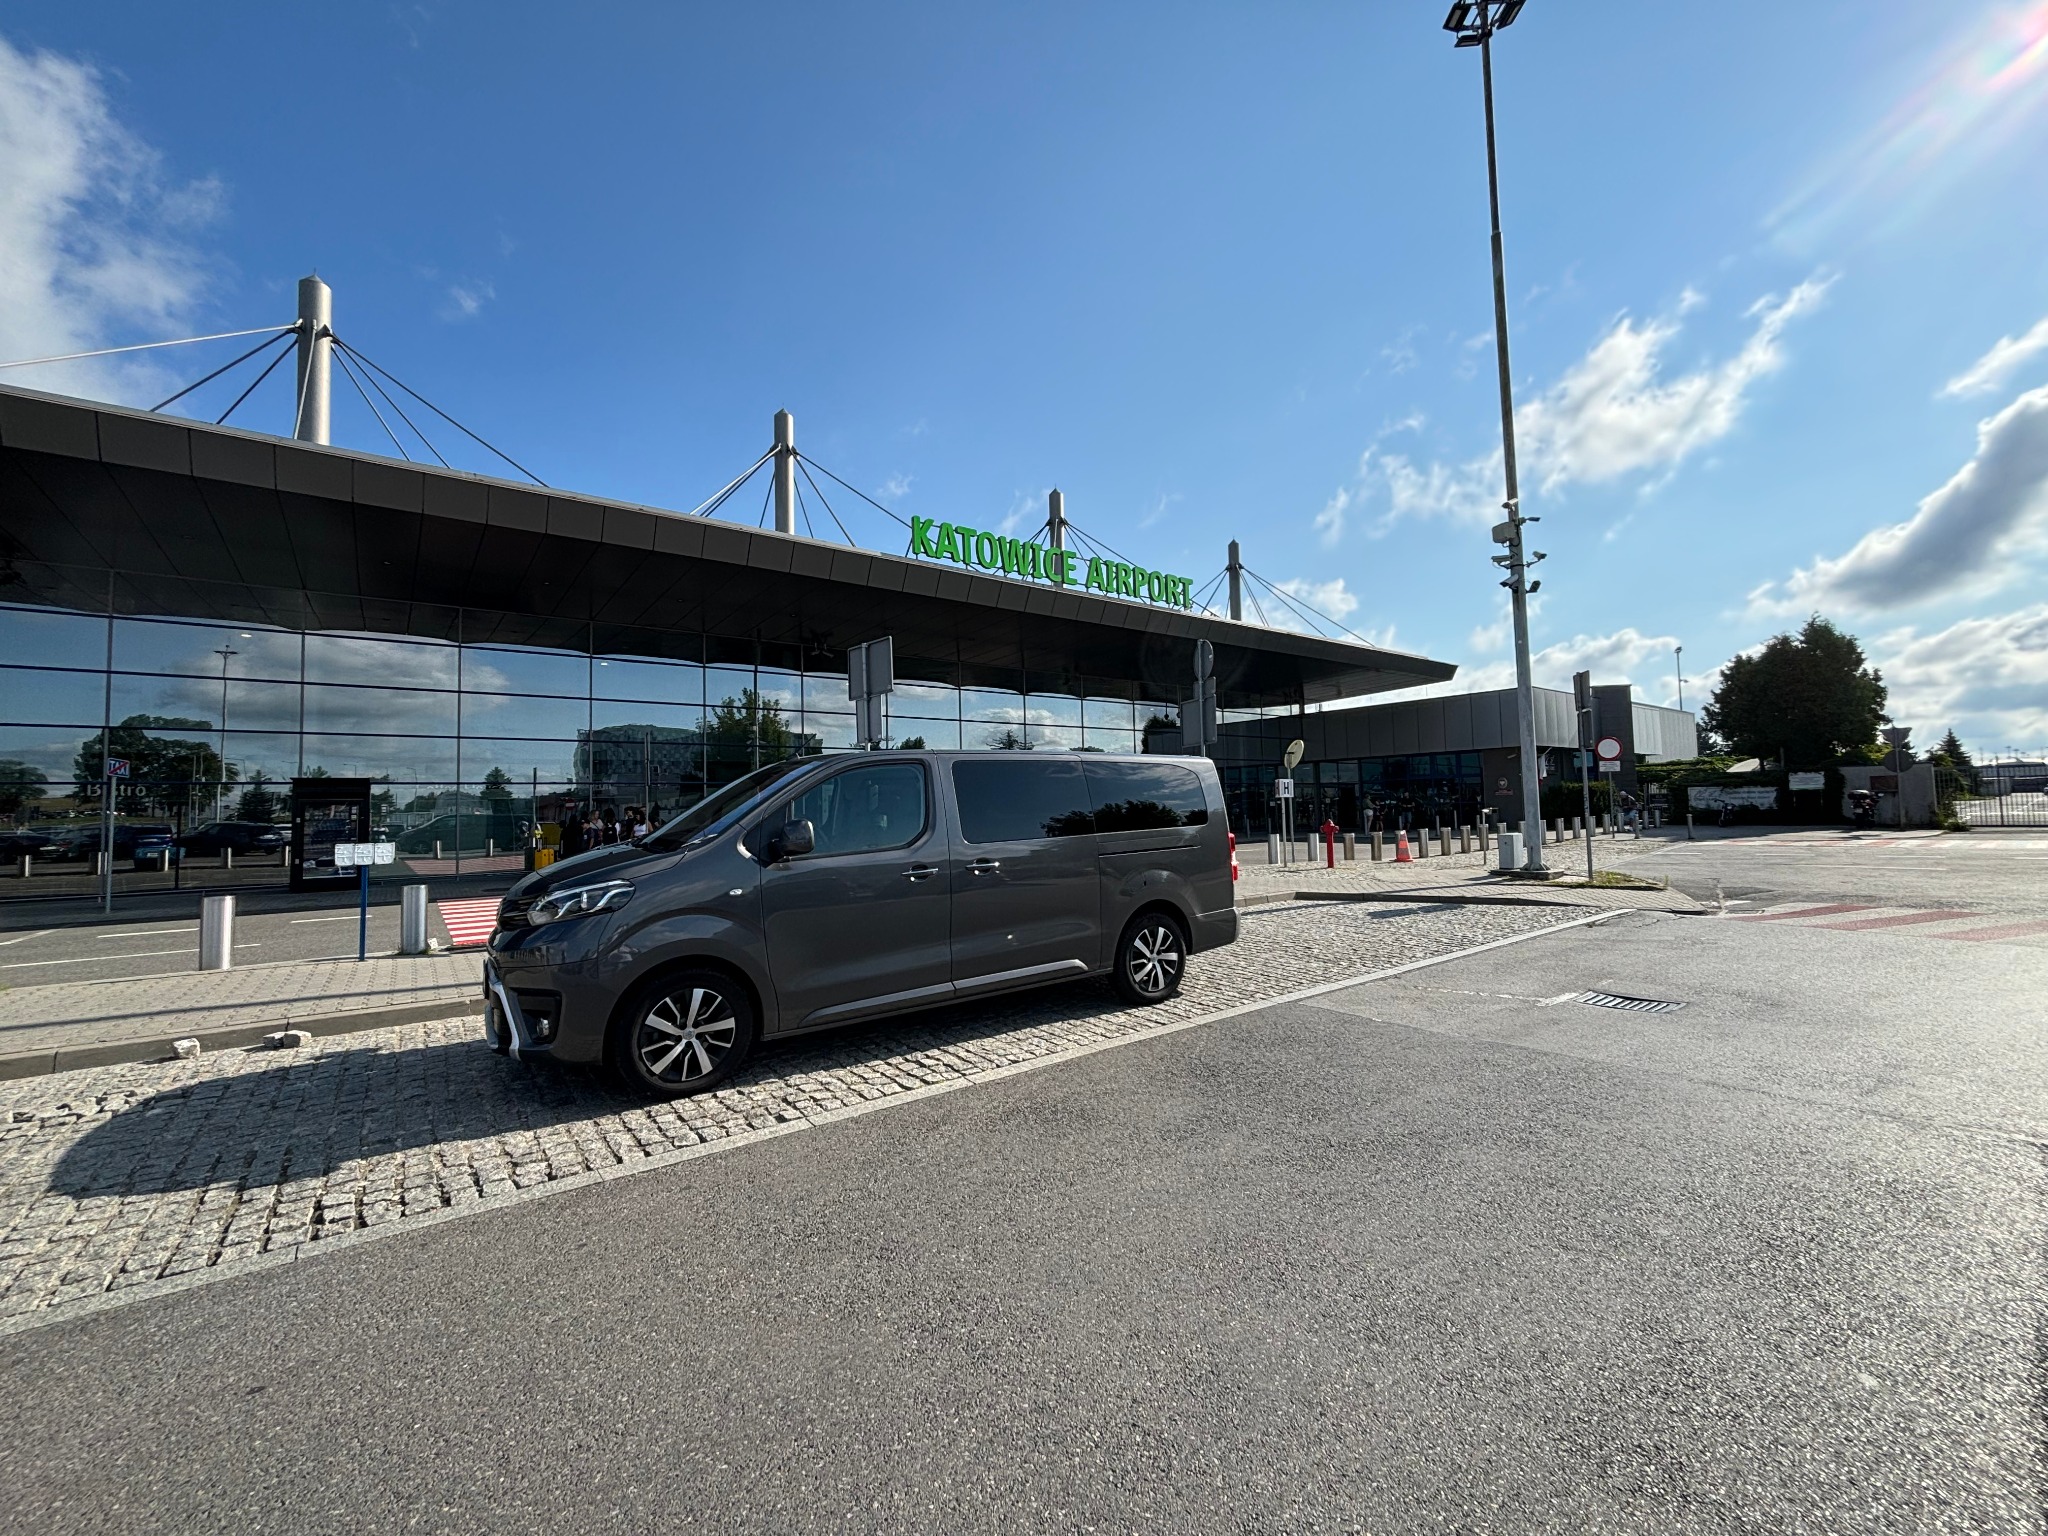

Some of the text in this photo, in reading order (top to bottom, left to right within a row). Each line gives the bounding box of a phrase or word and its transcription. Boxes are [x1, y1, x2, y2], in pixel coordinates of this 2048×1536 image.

[912, 515, 1194, 609] KATOWICE AIRPORT
[109, 760, 129, 776] TAXI
[87, 784, 146, 797] Btro
[1283, 781, 1290, 794] H
